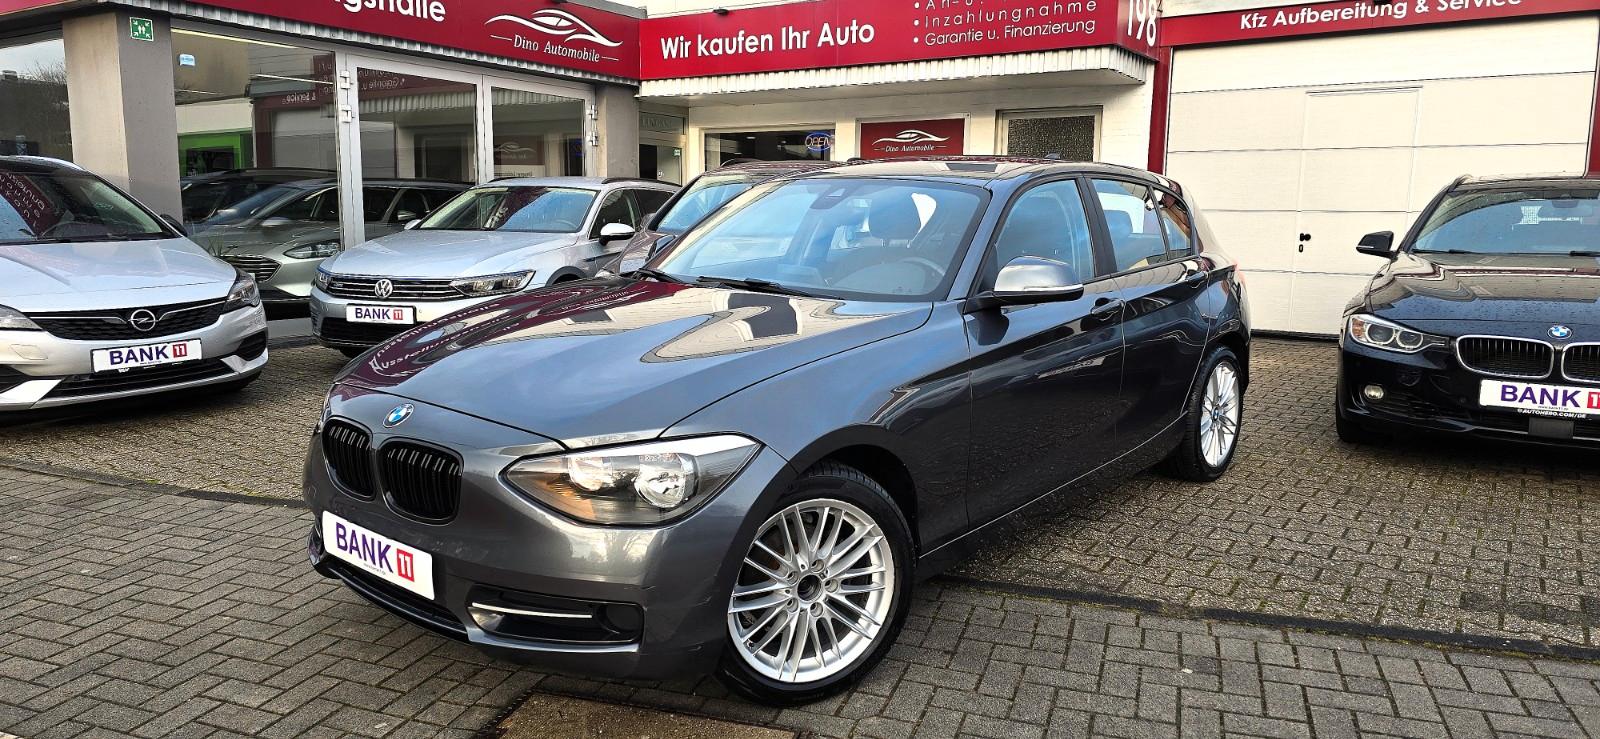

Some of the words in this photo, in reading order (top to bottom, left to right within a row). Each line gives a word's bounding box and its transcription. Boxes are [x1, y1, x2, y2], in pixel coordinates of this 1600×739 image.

[925, 0, 1097, 28] Inzahlungnahme
[1127, 0, 1157, 47] 198
[1240, 13, 1267, 30] Kfz
[1272, 2, 1408, 27] Aufbereitung
[1414, 0, 1430, 14] &
[660, 35, 692, 60] Wir
[697, 30, 773, 56] kaufen
[781, 25, 811, 50] Ihr
[817, 19, 875, 47] Auto
[925, 29, 984, 46] Garantie
[987, 30, 1000, 40] u.
[1004, 19, 1096, 39] Finanzierung
[513, 34, 539, 51] Dino
[543, 41, 600, 63] Automobile
[805, 136, 832, 147] OPEN
[355, 307, 391, 320] BANK
[394, 310, 402, 320] 11
[109, 345, 169, 366] BANK
[174, 344, 187, 357] 11
[1500, 384, 1581, 408] BANK
[335, 521, 394, 574] BANK
[398, 549, 413, 580] 11
